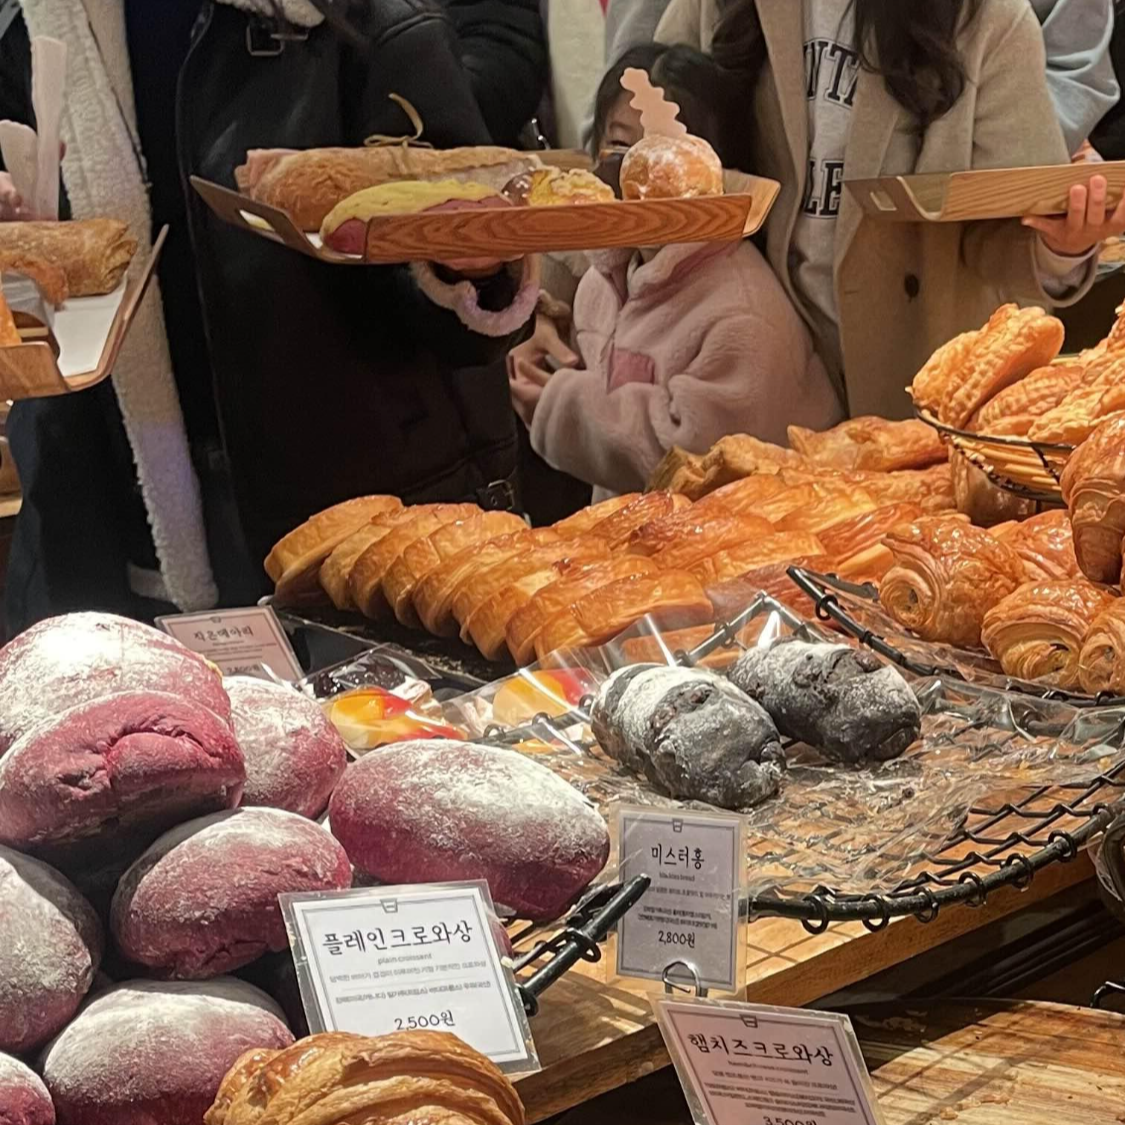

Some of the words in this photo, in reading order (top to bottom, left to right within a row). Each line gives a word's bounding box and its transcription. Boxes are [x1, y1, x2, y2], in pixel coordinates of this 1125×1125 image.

[651, 843, 705, 870] 미스터홍
[322, 920, 474, 956] 플레인크로와상
[658, 930, 696, 948] 2,800원
[394, 1010, 456, 1031] 2,500원
[688, 1033, 834, 1067] 햄치즈크로와상
